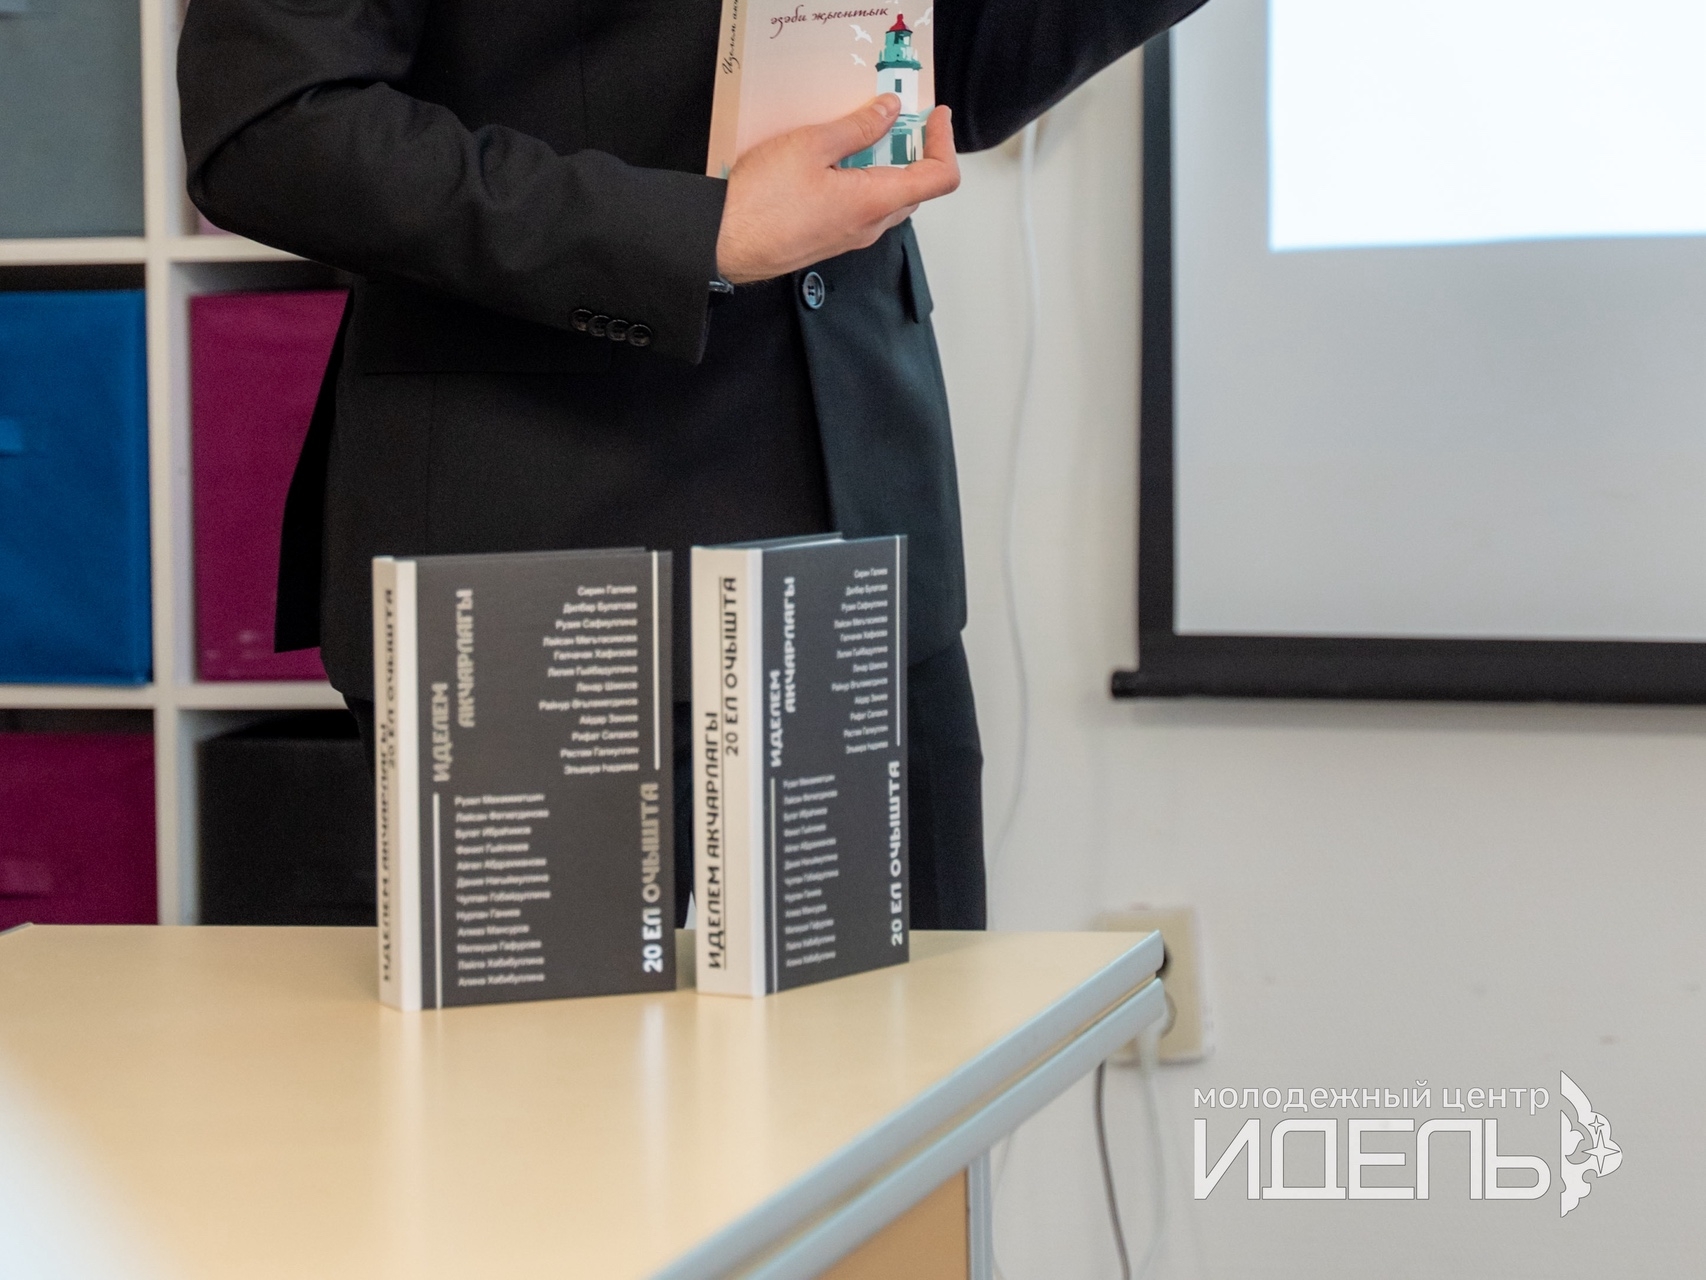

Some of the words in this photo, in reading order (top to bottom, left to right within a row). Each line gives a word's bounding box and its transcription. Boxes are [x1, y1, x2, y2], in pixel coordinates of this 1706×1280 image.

[455, 589, 475, 728] АКЧАРЛАГЫ
[723, 577, 738, 689] ОЧЫШТА
[784, 577, 796, 713] АКЧАРЛАГЫ
[431, 682, 453, 782] ИДЕЛЕМ
[725, 696, 739, 725] ЕЛ
[725, 732, 739, 757] 20
[770, 670, 783, 767] ИДЕЛЕМ
[705, 712, 721, 858] АКЧАРЛАГЫ
[888, 761, 902, 877] ОЧЫШТА
[640, 782, 661, 903] ОЧЫШТА
[642, 907, 663, 941] ЕЛ
[708, 866, 724, 969] ИДЕЛЕМ
[890, 883, 902, 914] ЕЛ
[891, 918, 903, 946] 20
[643, 948, 663, 974] 20
